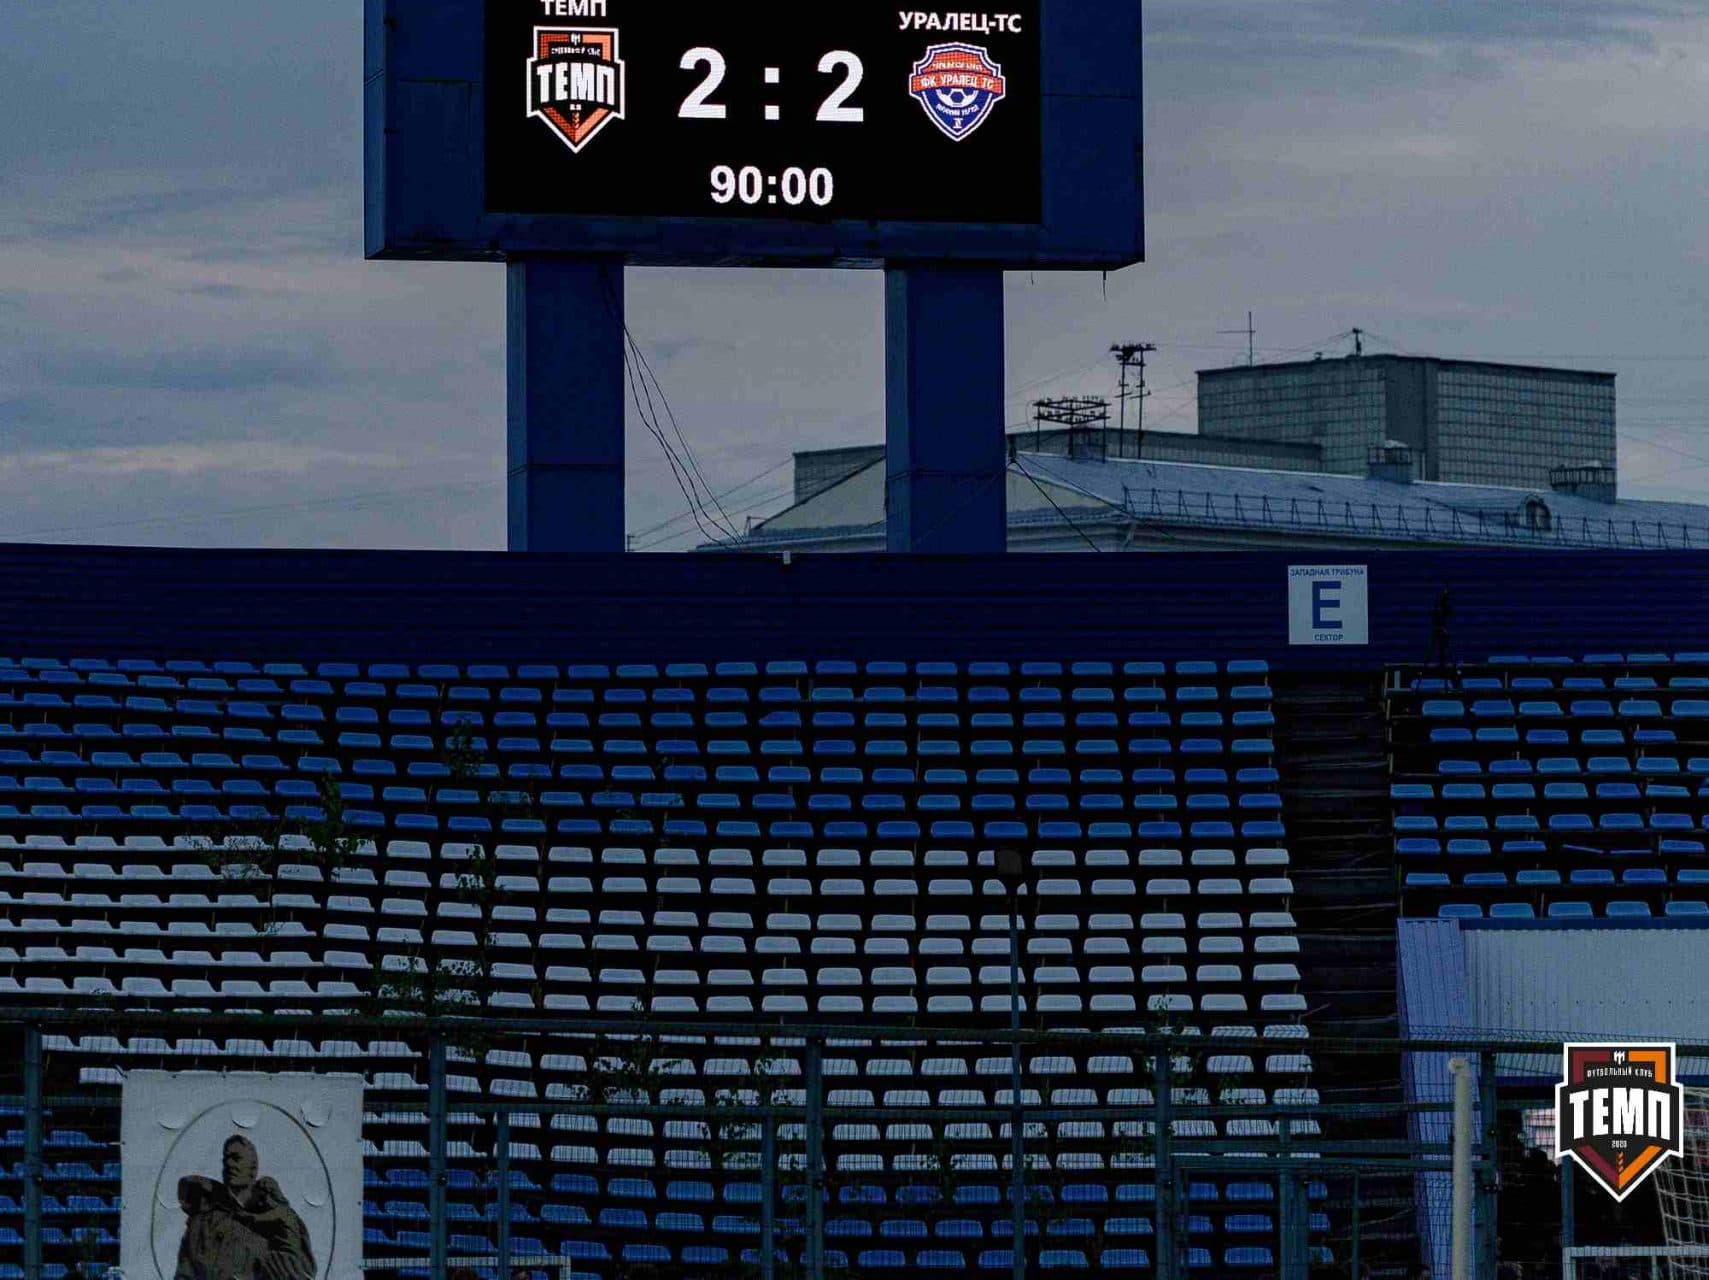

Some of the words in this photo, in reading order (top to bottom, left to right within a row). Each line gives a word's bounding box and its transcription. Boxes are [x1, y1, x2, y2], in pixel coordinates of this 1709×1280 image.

[899, 11, 1022, 35] УРАЛЕЦ-ТС
[536, 62, 615, 106] ТЕМП
[678, 46, 727, 119] 2
[816, 50, 864, 122] 2
[941, 74, 978, 87] УРАЛЕЦ
[710, 165, 834, 206] 90:00
[1312, 581, 1343, 629] Е
[1314, 633, 1344, 641] СЕКТОР
